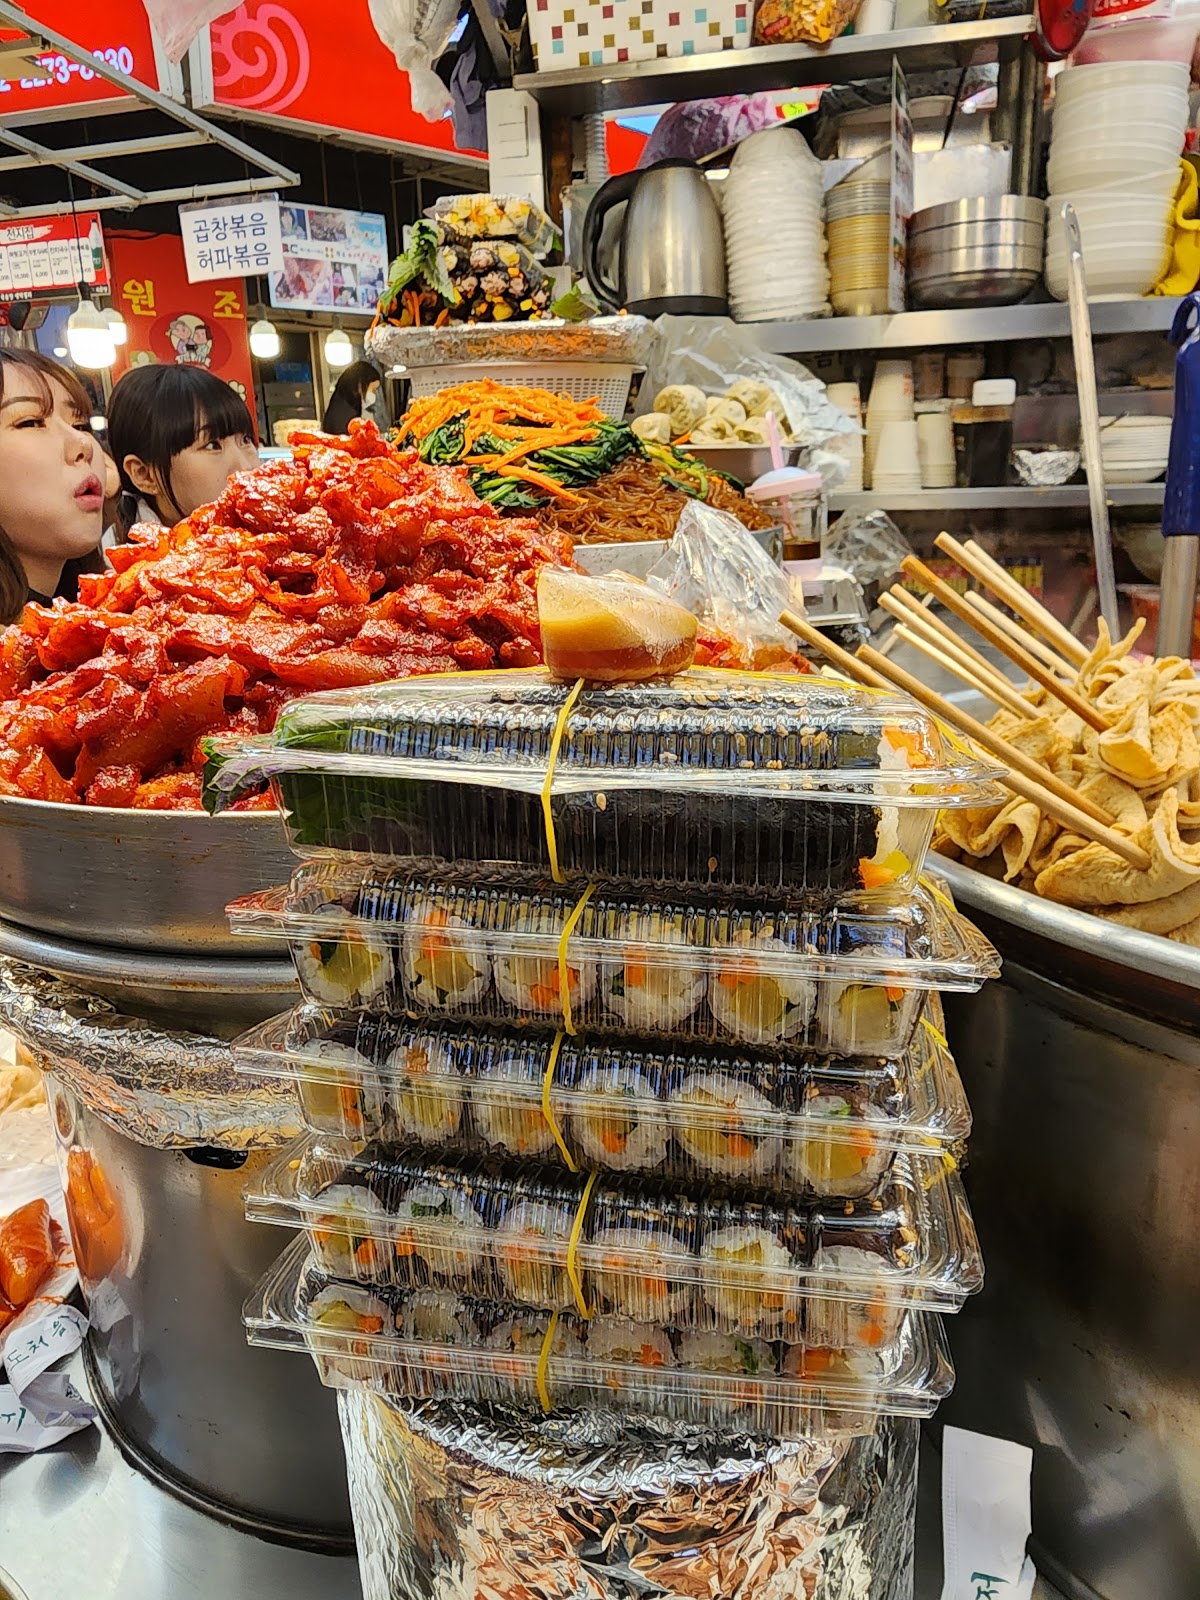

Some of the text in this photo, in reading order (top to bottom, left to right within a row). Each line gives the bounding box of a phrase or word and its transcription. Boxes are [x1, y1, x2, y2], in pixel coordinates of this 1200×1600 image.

[193, 212, 268, 243] 곱창볶음
[197, 242, 271, 272] 허파볶음
[122, 279, 244, 319] 원 조
